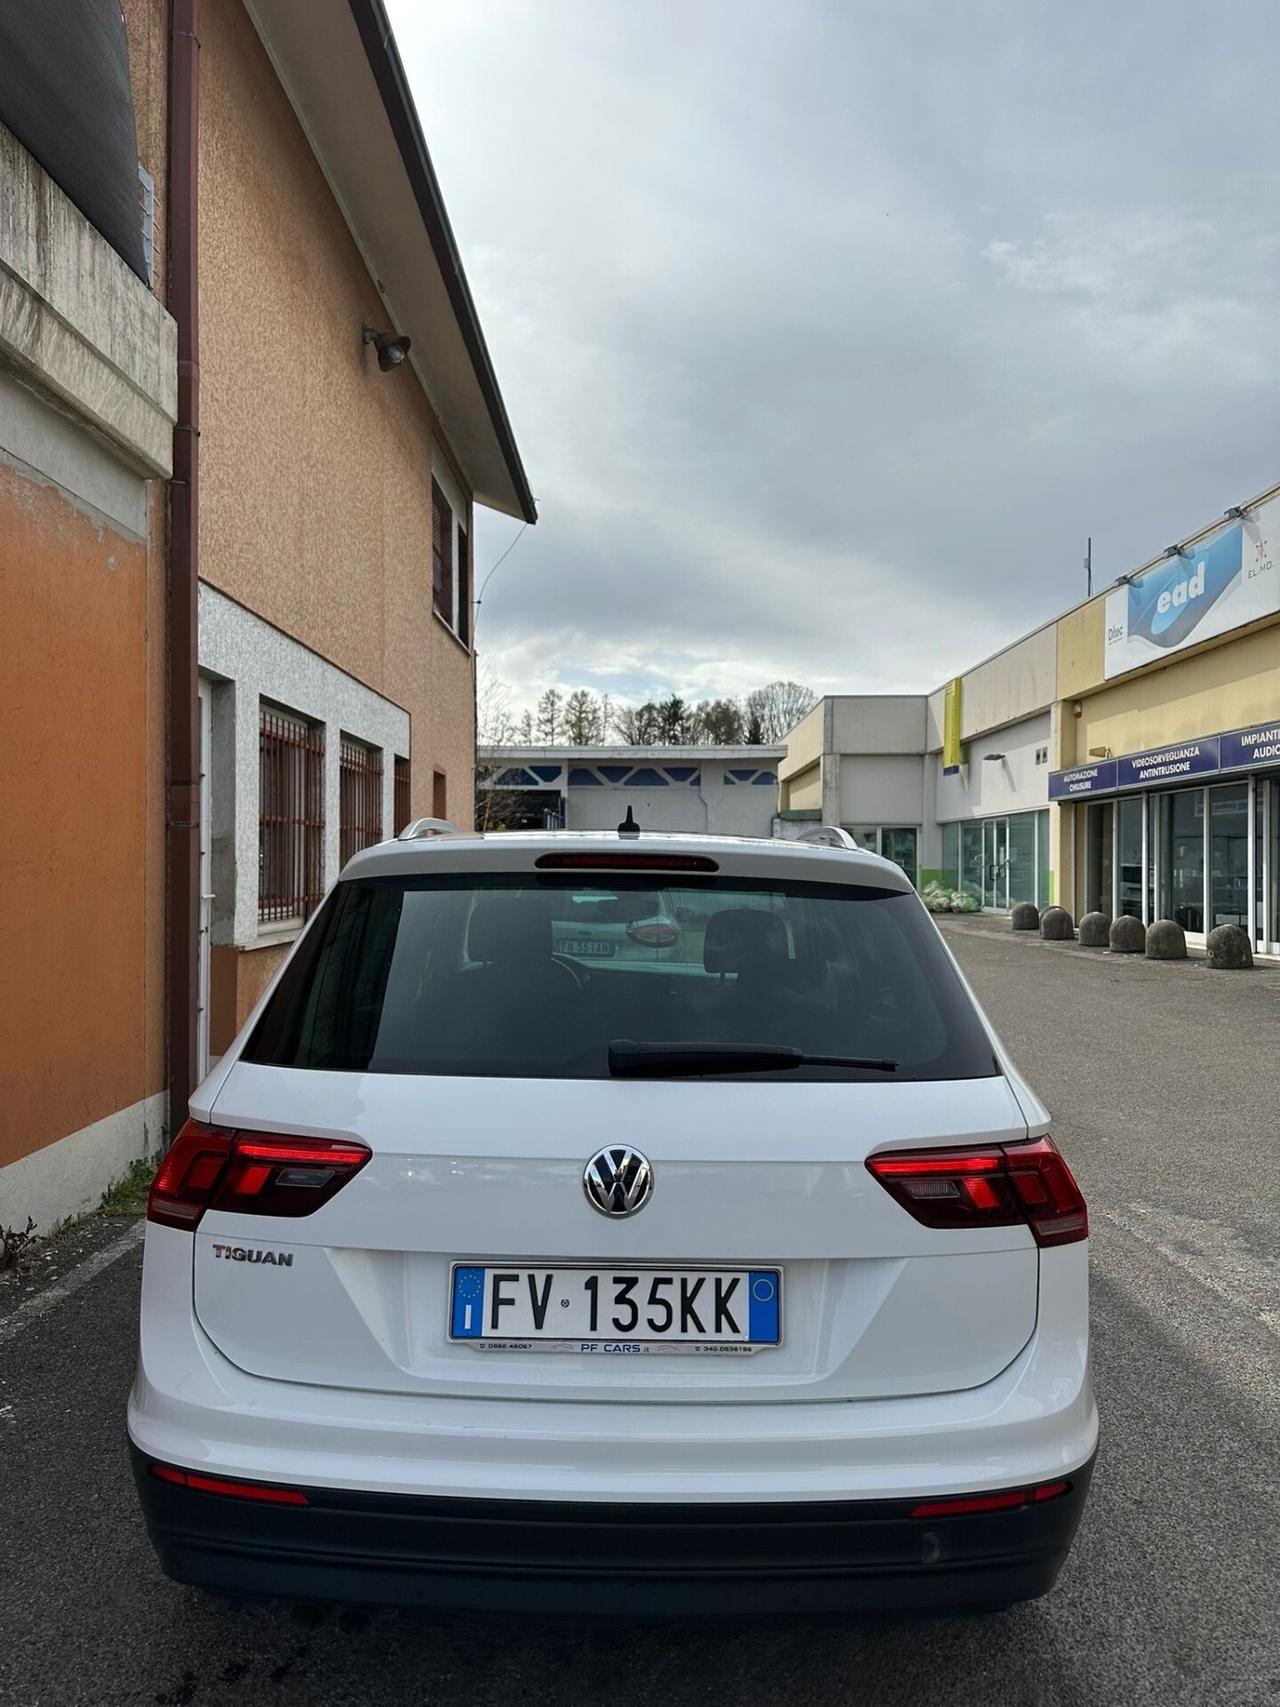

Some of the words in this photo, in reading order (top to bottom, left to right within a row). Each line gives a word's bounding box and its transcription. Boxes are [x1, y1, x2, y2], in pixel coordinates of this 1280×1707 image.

[1157, 561, 1205, 614] ead
[1241, 728, 1280, 747] IMPIANTI
[1132, 746, 1200, 769] VIDEOSORVEGLIANZA
[1063, 767, 1098, 783] AUTOMAZIONE
[1138, 761, 1191, 780] ANTINTRUSIONE
[1069, 780, 1092, 792] CHIUSURE
[212, 1243, 294, 1267] TIGUAN
[490, 1273, 554, 1330] FV
[584, 1274, 742, 1333] 135KK
[580, 1343, 598, 1352] PF
